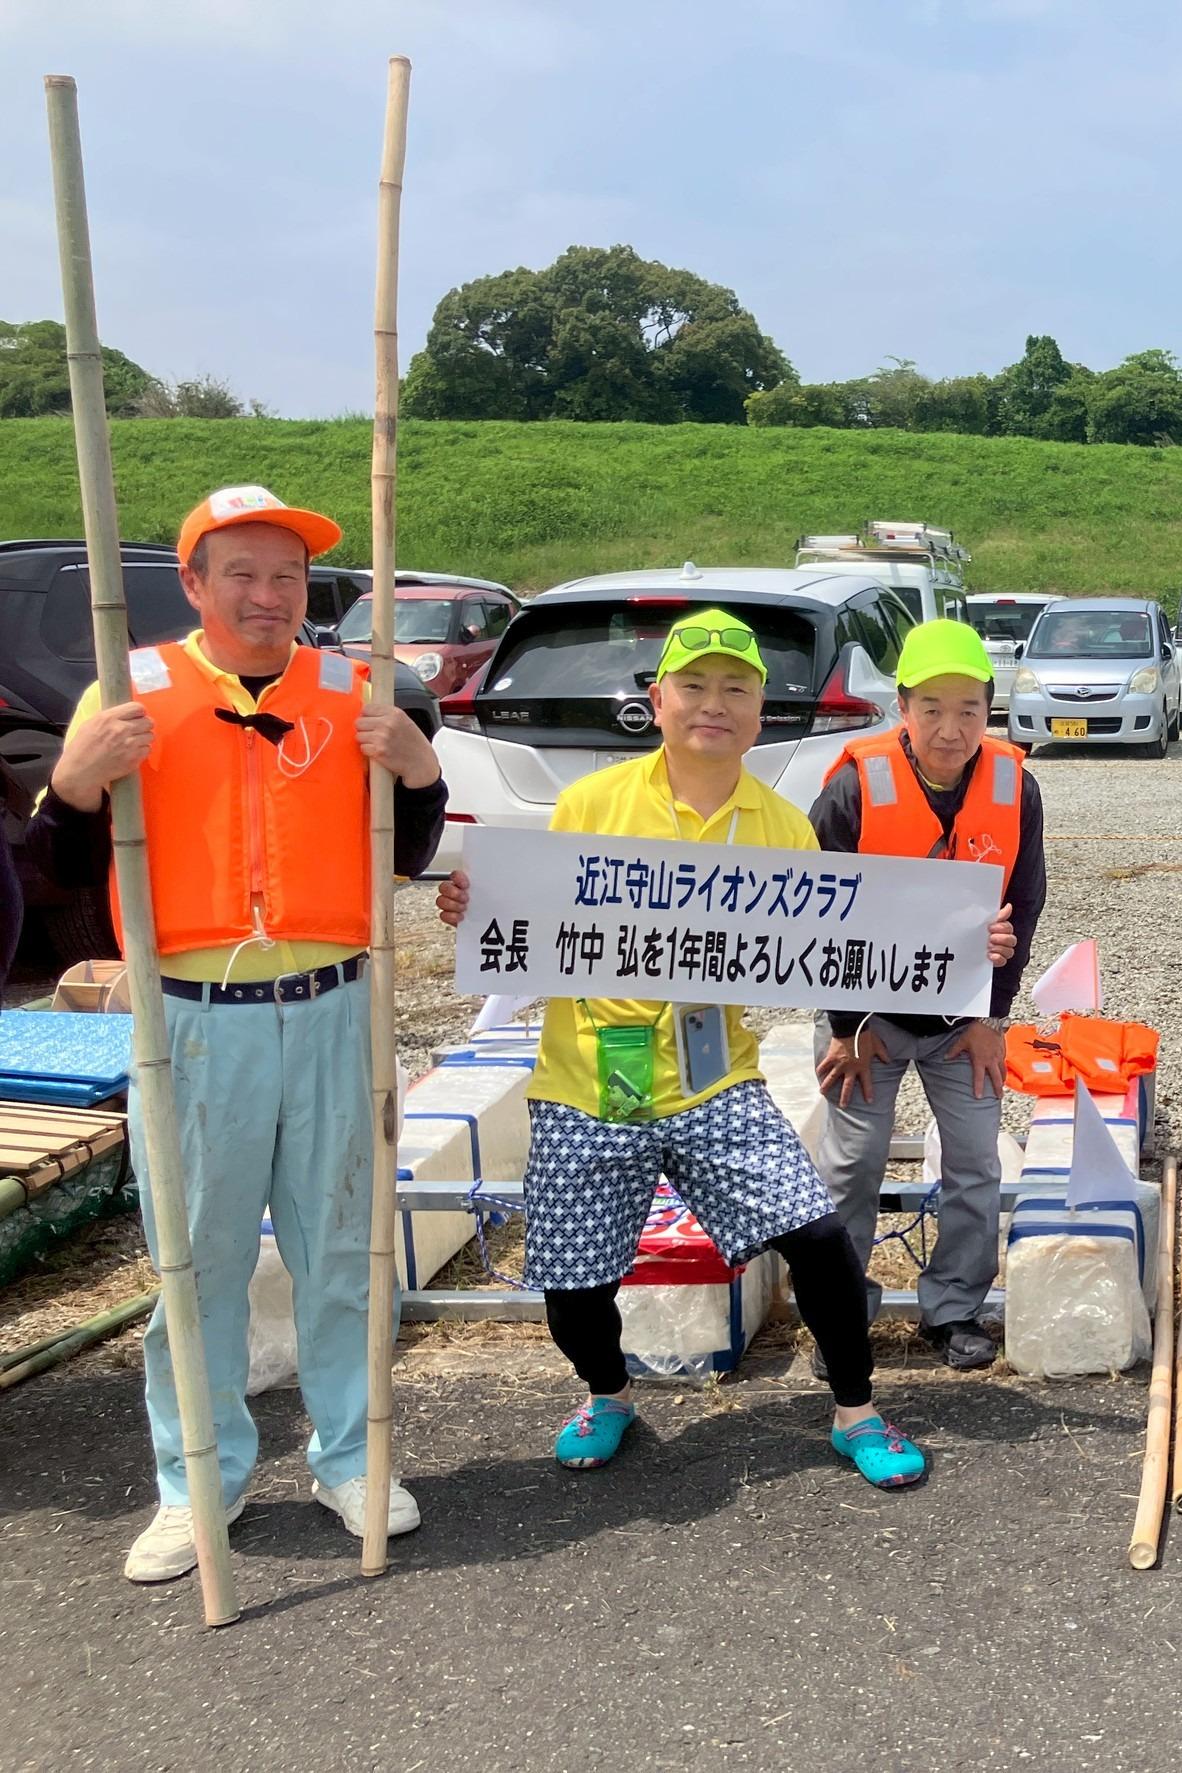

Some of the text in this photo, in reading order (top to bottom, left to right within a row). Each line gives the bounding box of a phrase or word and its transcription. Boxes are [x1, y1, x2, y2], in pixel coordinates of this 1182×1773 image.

[492, 710, 530, 720] LEAF
[575, 854, 863, 921] 近江守山ライオンズクラブ
[480, 917, 955, 994] 会長 竹中 弘を1年間よろしくお願いします
